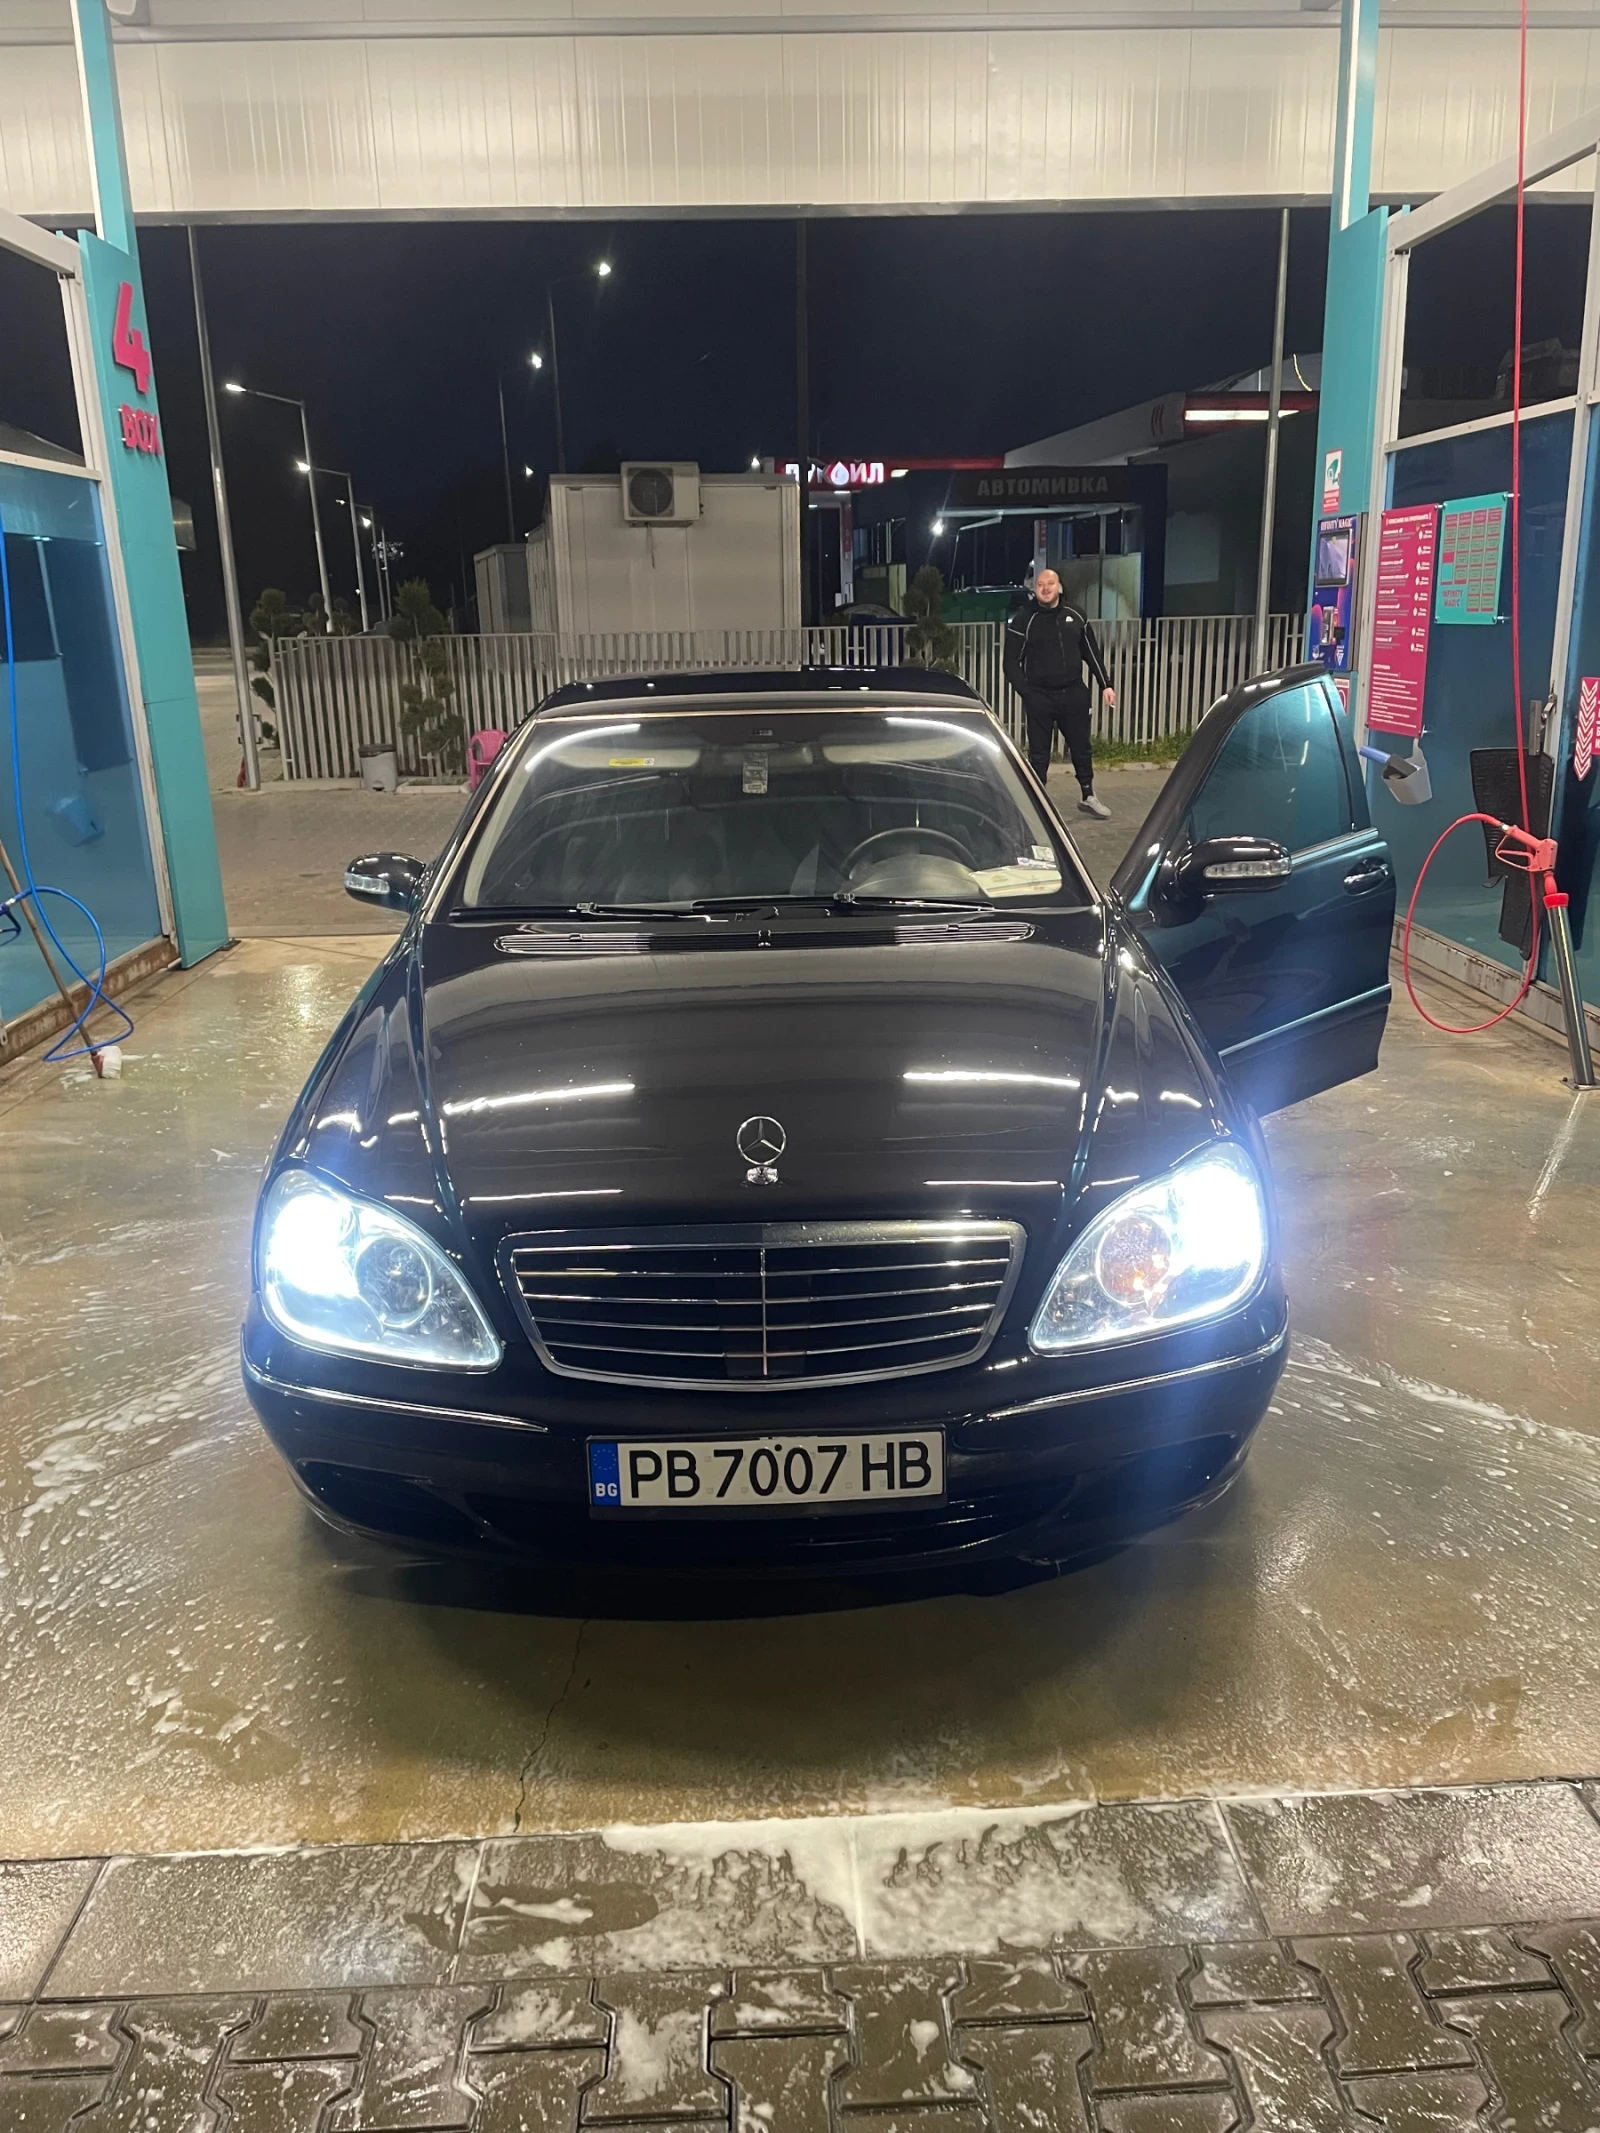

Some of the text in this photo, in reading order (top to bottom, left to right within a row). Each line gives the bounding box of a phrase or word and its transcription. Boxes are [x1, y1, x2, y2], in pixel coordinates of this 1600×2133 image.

[113, 281, 151, 394] 4
[120, 403, 163, 456] BOX
[977, 476, 1109, 496] АВТОМИВКА
[595, 1482, 618, 1497] BG
[628, 1441, 932, 1499] PB 7007 HB
